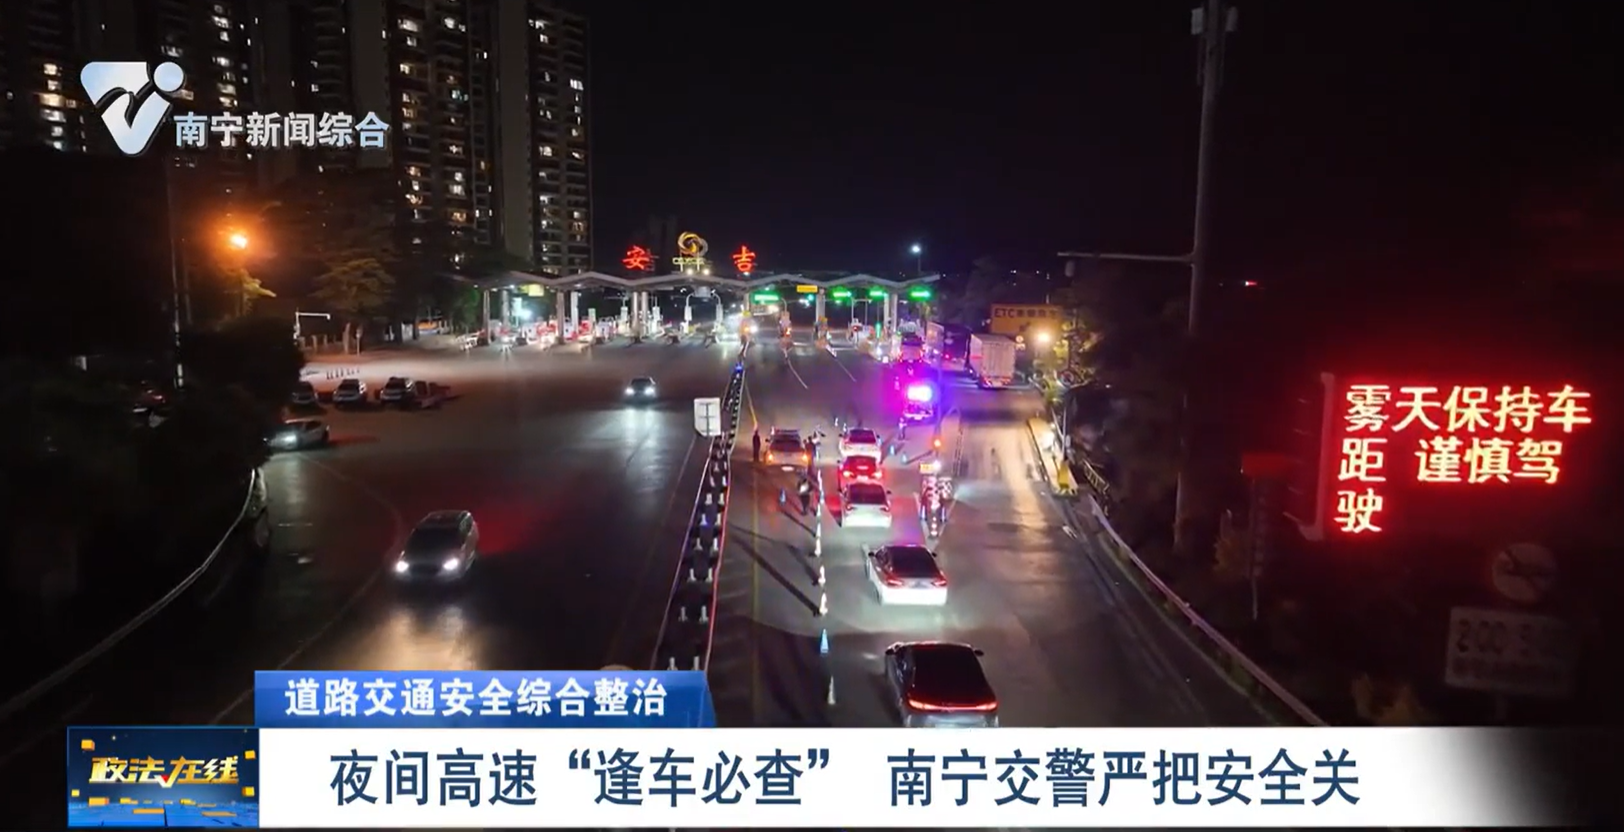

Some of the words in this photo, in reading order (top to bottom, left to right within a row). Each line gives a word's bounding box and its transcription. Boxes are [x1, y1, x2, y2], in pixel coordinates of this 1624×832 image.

[623, 245, 650, 270] 安
[732, 245, 756, 272] 吉
[1345, 384, 1592, 433] 雾天保持车
[1337, 438, 1388, 482] 距
[1415, 435, 1562, 484] 谨慎驾
[1334, 488, 1383, 534] 驶
